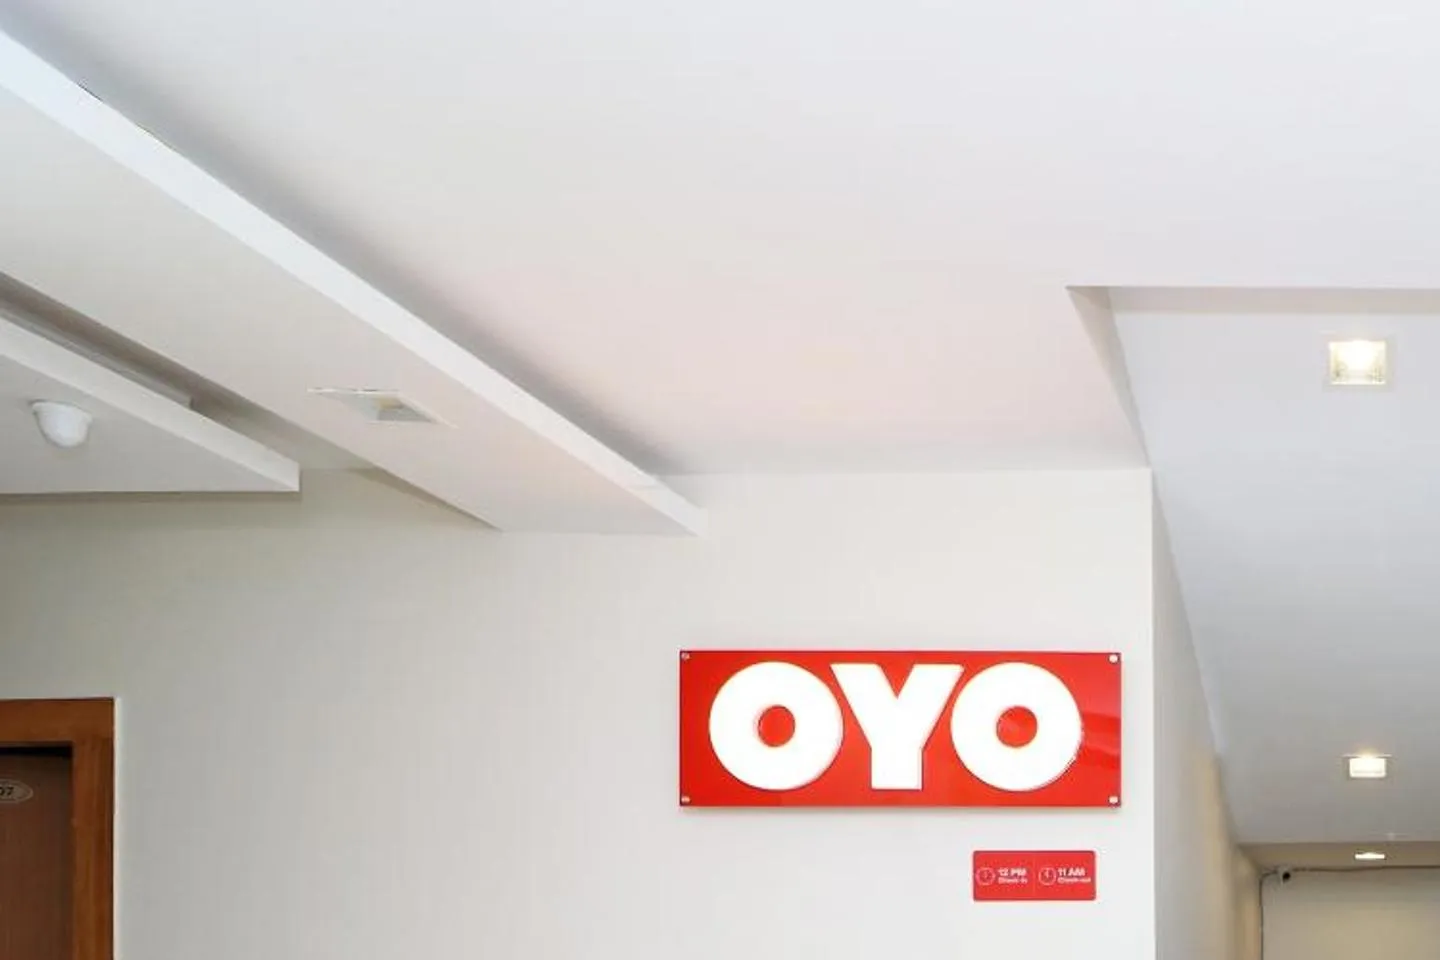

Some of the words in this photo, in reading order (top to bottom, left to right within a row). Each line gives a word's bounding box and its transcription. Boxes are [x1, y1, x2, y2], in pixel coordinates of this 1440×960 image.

[709, 661, 1083, 791] OYO
[998, 867, 1009, 876] 12
[1010, 867, 1027, 876] PM
[1057, 867, 1067, 876] 11
[1068, 867, 1085, 876] AM
